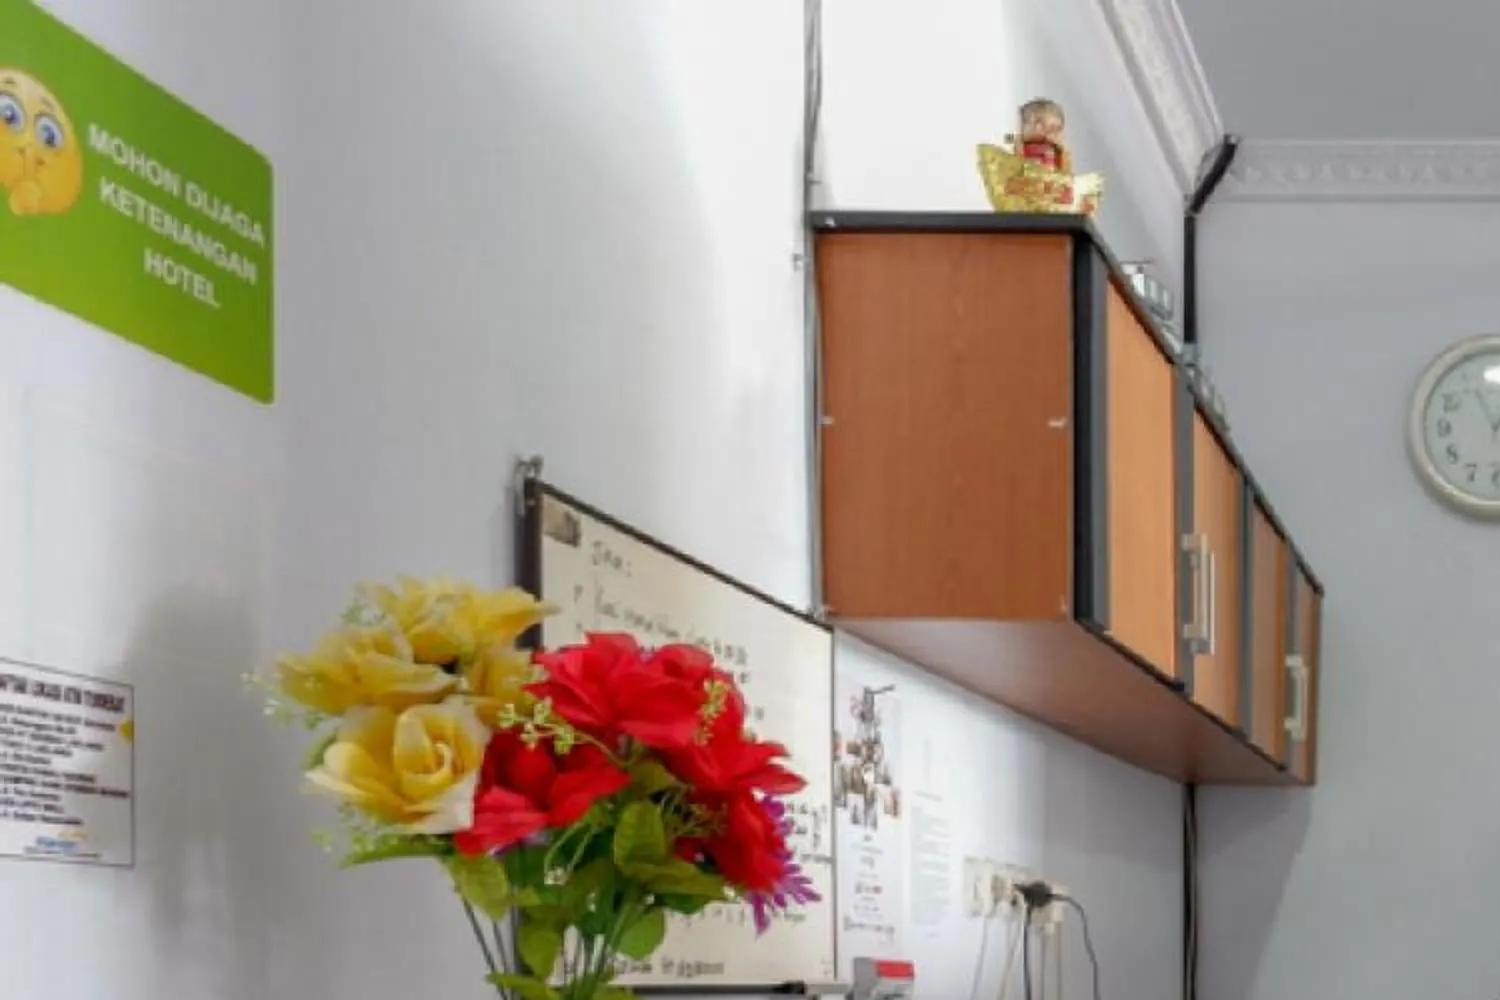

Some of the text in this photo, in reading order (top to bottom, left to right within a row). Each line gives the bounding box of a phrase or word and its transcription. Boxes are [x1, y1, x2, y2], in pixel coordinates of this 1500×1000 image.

[88, 122, 181, 198] MOHON
[99, 176, 258, 286] KETENANGAN
[144, 246, 221, 308] HOTEL
